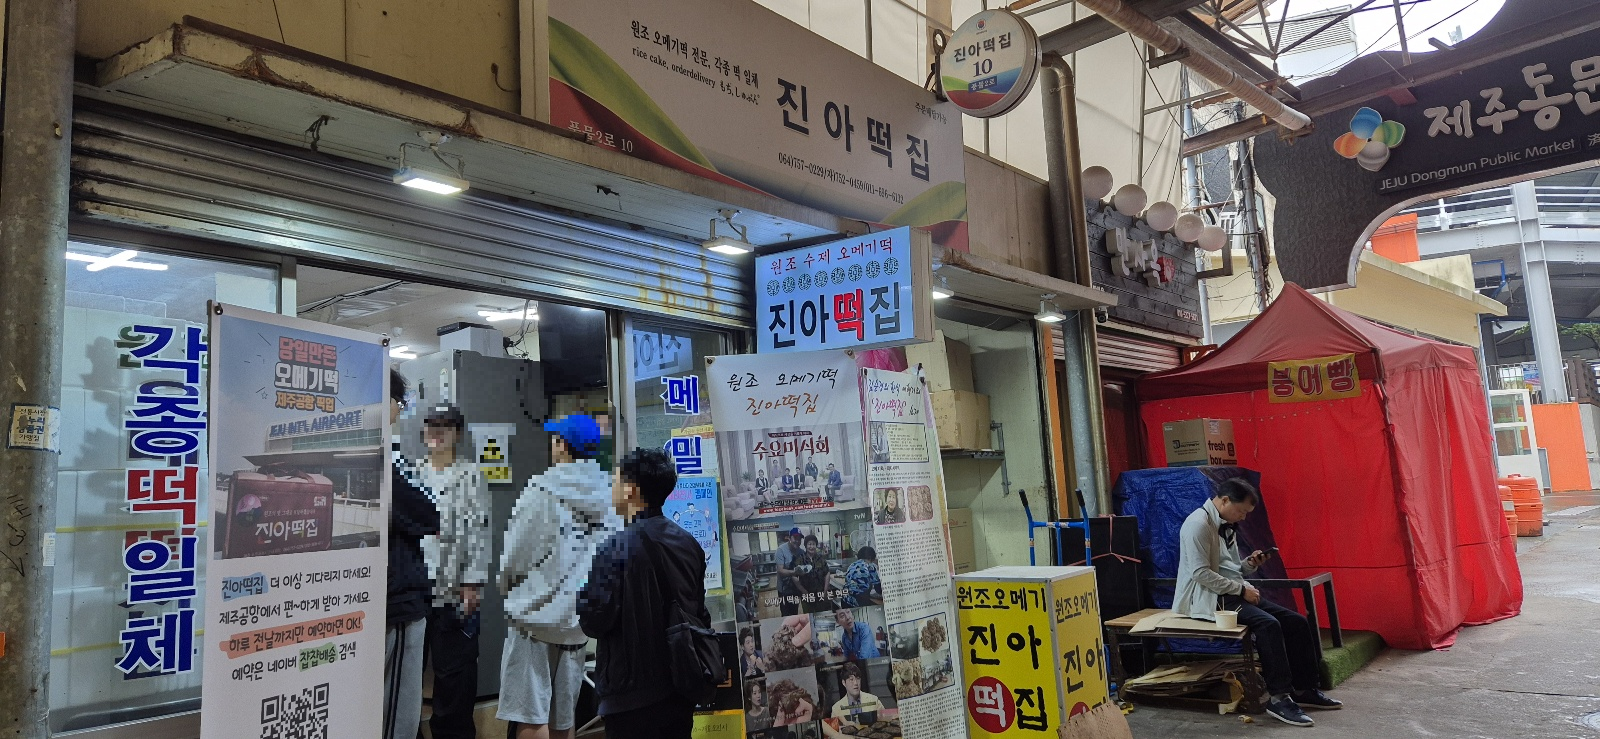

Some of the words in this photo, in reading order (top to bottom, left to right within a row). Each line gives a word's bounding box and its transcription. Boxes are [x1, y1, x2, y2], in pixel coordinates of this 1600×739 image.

[631, 20, 650, 40] 원조
[653, 31, 688, 59] 오메기떡
[714, 56, 731, 77] 각종
[733, 65, 740, 81] 떡
[743, 70, 759, 89] 일체
[953, 32, 1011, 62] 진아떡집
[632, 46, 648, 59] rice
[649, 55, 669, 70] cake,
[671, 63, 716, 88] orderdelivery
[973, 58, 993, 77] 10
[621, 139, 633, 152] 10
[776, 78, 930, 182] 진아떡집
[1379, 176, 1408, 190] JEJU
[1411, 159, 1477, 184] Dongmun
[1481, 151, 1521, 170] Public
[1525, 138, 1576, 159] Market
[771, 257, 797, 275] 원조
[803, 249, 831, 268] 수제
[837, 237, 893, 261] 오메기떡
[768, 282, 900, 349] 진아떡집
[278, 335, 337, 367] 당일만든
[274, 362, 339, 394] 오메기떡
[727, 373, 759, 392] 원조
[776, 368, 839, 389] 오메기떡
[1272, 357, 1356, 397] 붕어빵
[275, 391, 316, 411] 제주공항
[746, 393, 819, 418] 진아떡집
[311, 409, 362, 431] AIRPORT
[752, 435, 829, 461] 수요미식회
[1208, 440, 1226, 451] fresh
[1210, 455, 1223, 465] box
[115, 322, 207, 677] 각종떡일체
[255, 519, 319, 544] 진아떡집
[221, 576, 263, 599] 진아떡집
[270, 576, 280, 588] 더
[282, 572, 303, 590] 이상
[305, 570, 341, 584] 기다리지
[342, 566, 371, 579] 마세요!
[801, 593, 816, 603] 처음
[817, 592, 825, 601] 맛
[826, 591, 834, 600] 본
[219, 604, 281, 626] 제주공항에서
[283, 600, 320, 619] 편~하게
[322, 596, 341, 612] 받아
[343, 591, 371, 603] 가세요
[957, 586, 1047, 612] 원조오메기
[229, 639, 250, 652] 하루
[253, 626, 305, 652] 전날까지만
[307, 620, 344, 638] 예약하면
[346, 617, 361, 629] OK!
[231, 661, 264, 682] 예약은
[267, 656, 297, 673] 네이버
[338, 641, 357, 661] 검색
